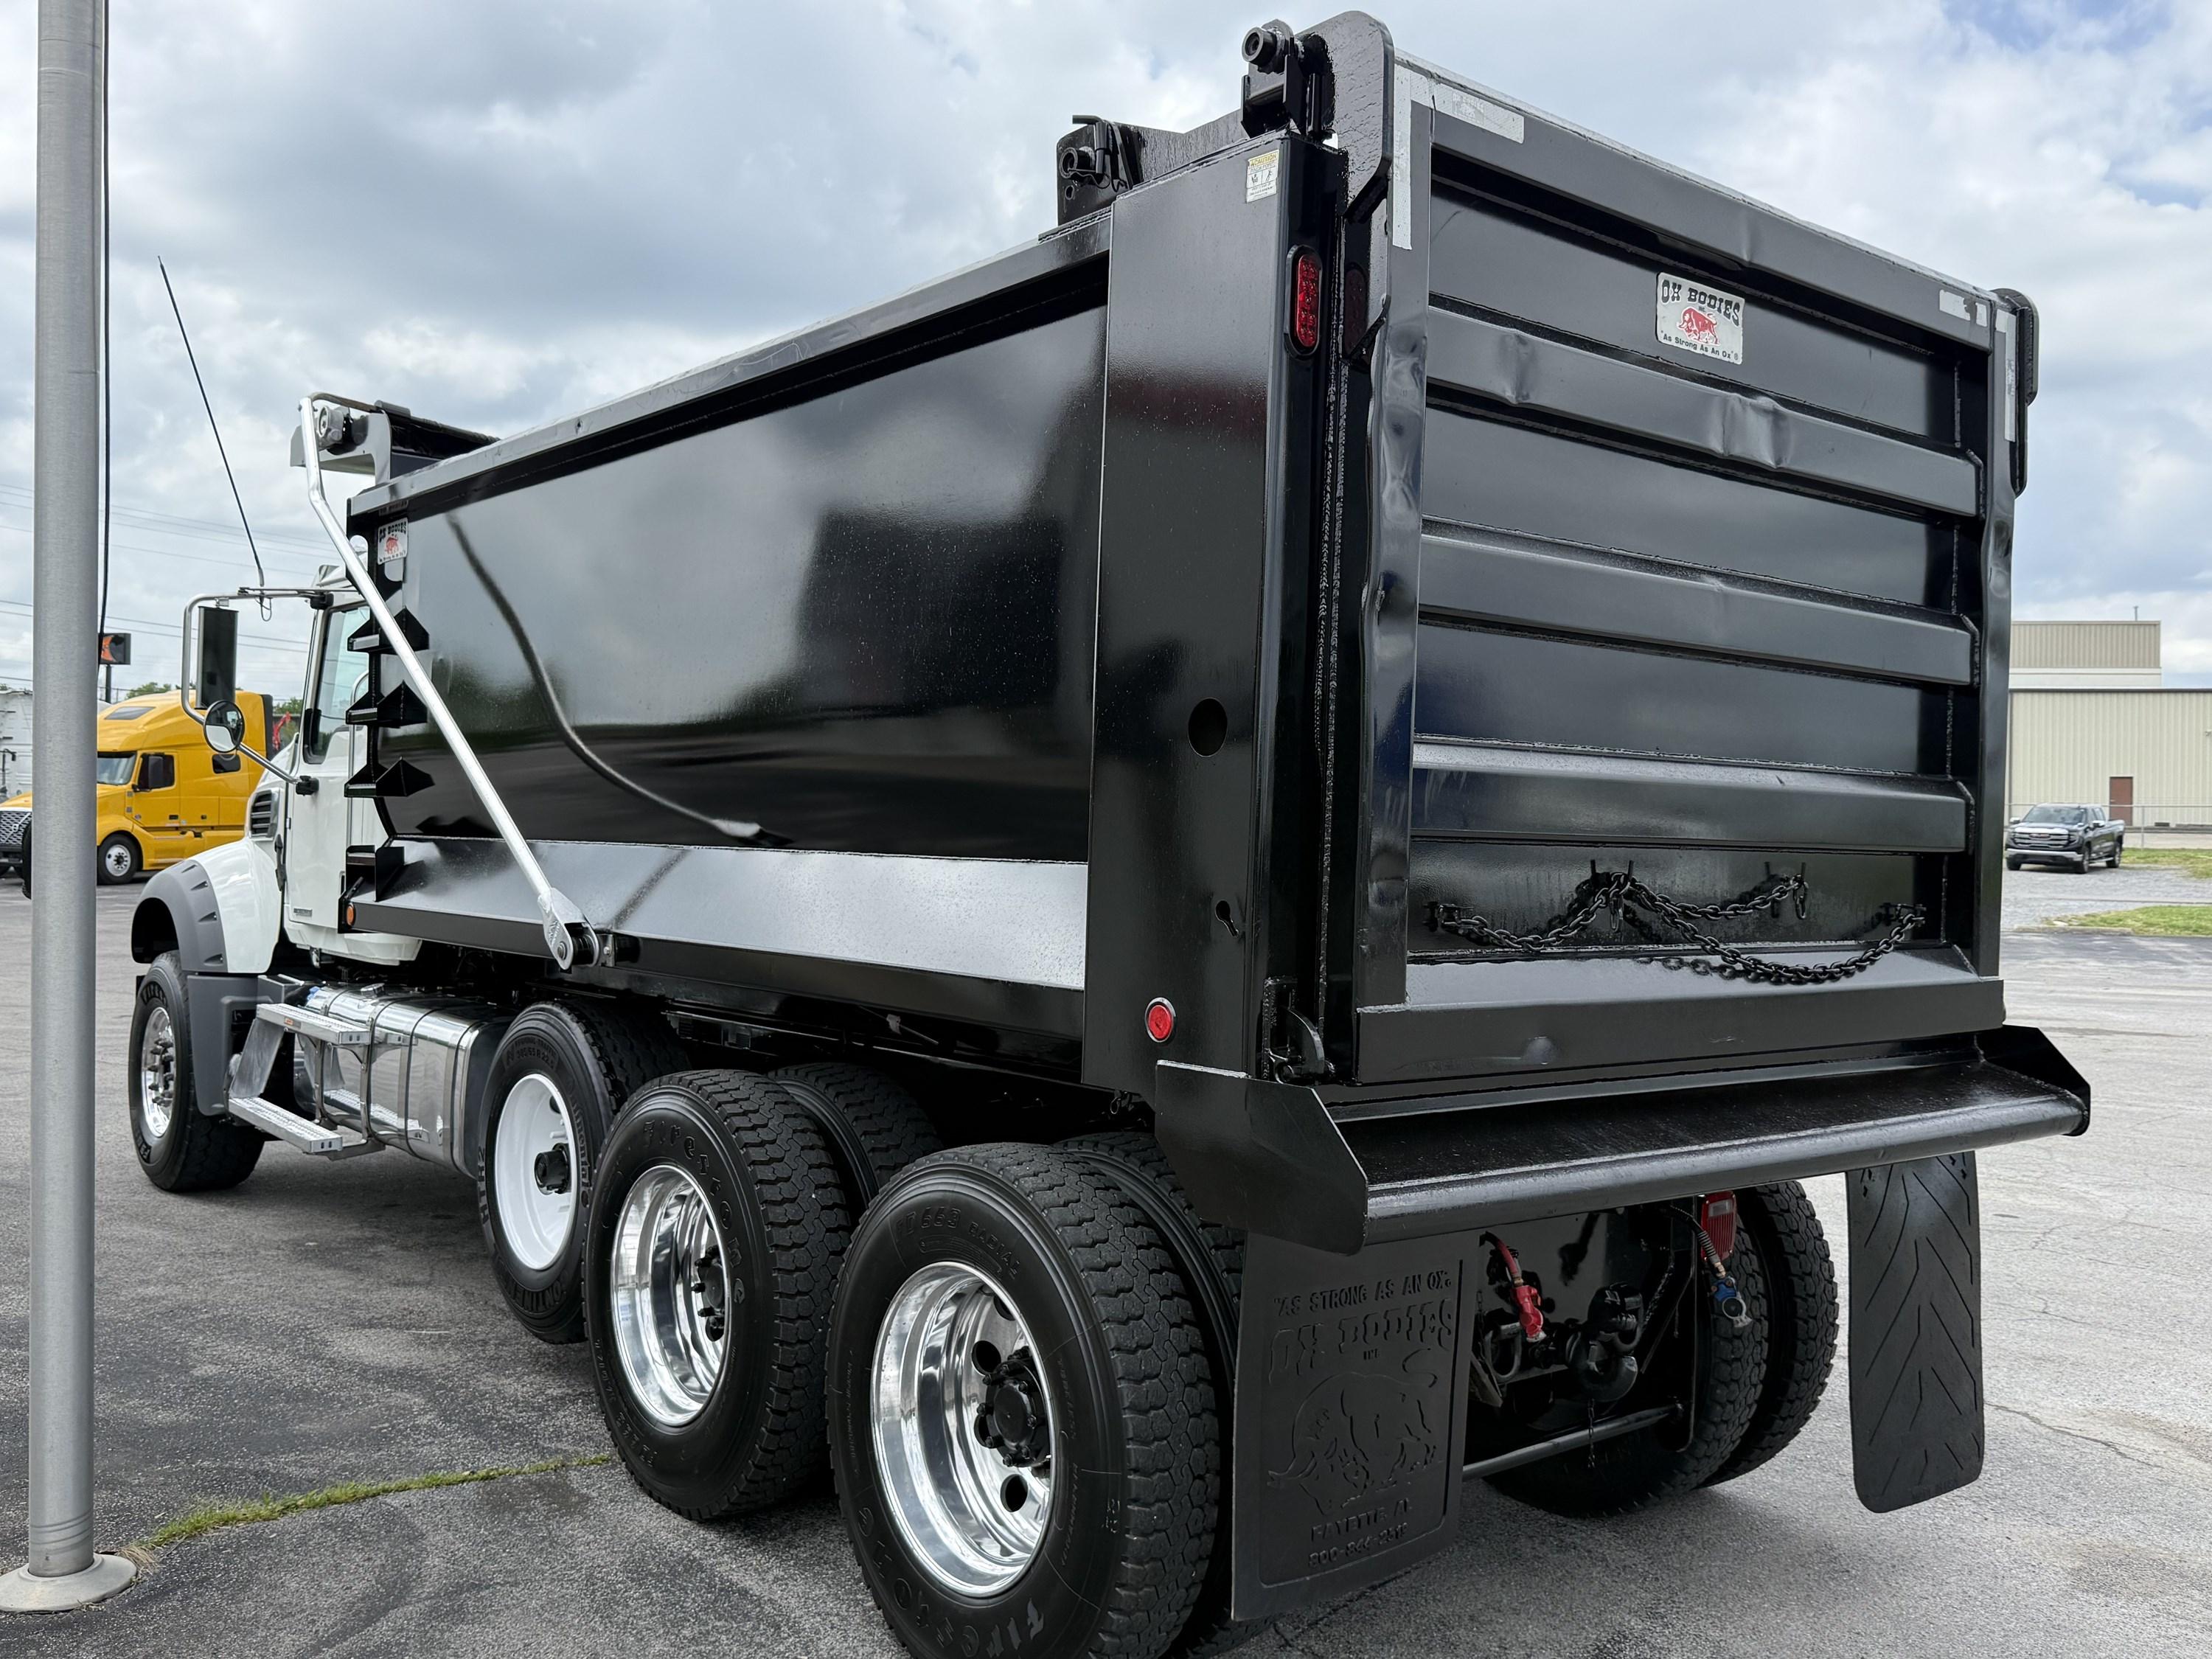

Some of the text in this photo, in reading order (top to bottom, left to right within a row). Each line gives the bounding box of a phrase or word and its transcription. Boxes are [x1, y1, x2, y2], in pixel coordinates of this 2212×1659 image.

[1253, 153, 1277, 166] CAUTION
[1661, 279, 1741, 327] OX BODIES
[1674, 337, 1698, 350] Strong
[1700, 344, 1708, 352] As
[1711, 348, 1720, 357] An
[643, 1119, 745, 1305] Firestone
[921, 1205, 961, 1229] 663
[967, 1221, 1021, 1281] RADIAL
[1310, 1284, 1368, 1313] STRONG
[1374, 1279, 1395, 1301] AS
[1402, 1274, 1422, 1295] AN
